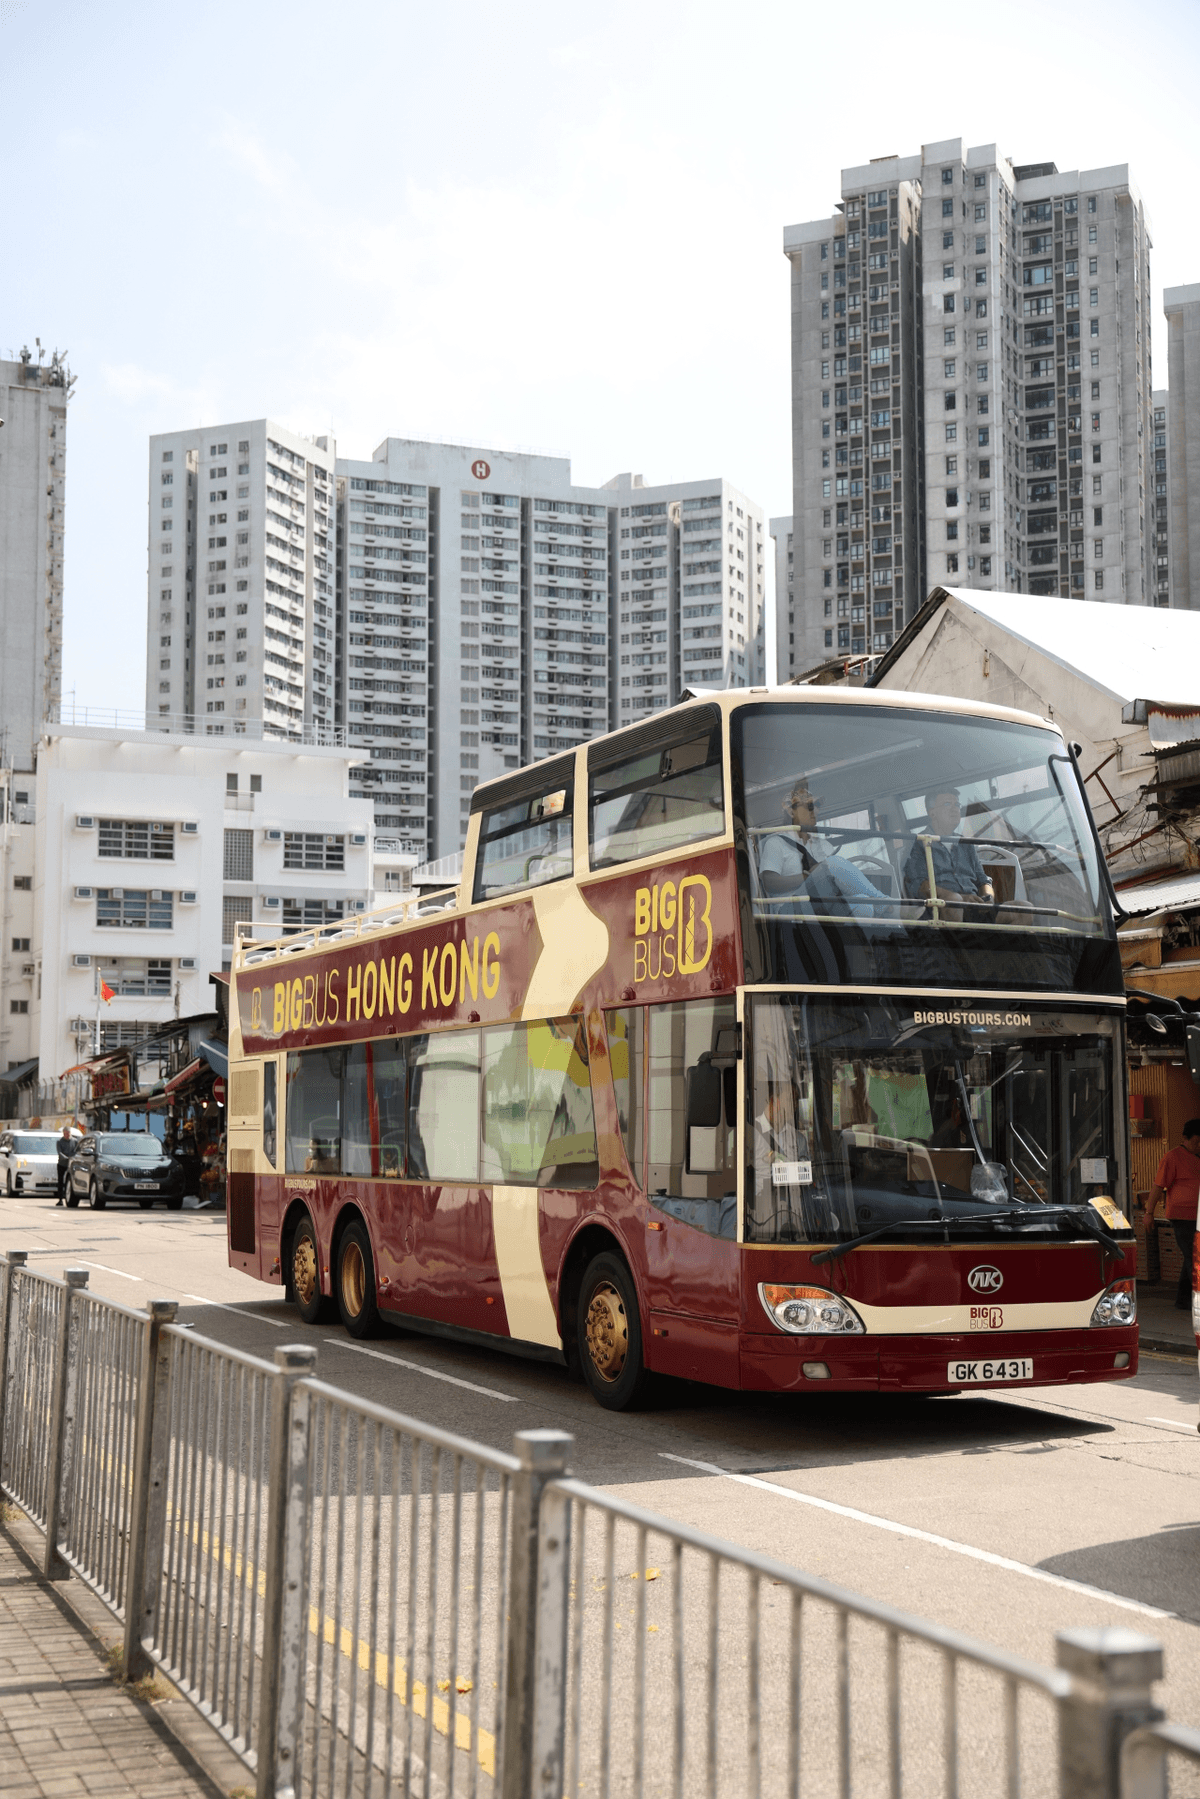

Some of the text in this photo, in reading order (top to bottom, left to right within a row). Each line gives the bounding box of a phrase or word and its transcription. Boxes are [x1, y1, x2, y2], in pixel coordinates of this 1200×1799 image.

[635, 881, 677, 936] BIG
[634, 934, 676, 982] BUS
[346, 952, 413, 1023] HONG
[421, 931, 501, 1011] KONG
[913, 1011, 1031, 1026] BIGBUSTOURS.COM
[970, 1307, 989, 1319] BIG
[969, 1318, 989, 1330] BUS
[955, 1361, 1026, 1380] GK 6431
